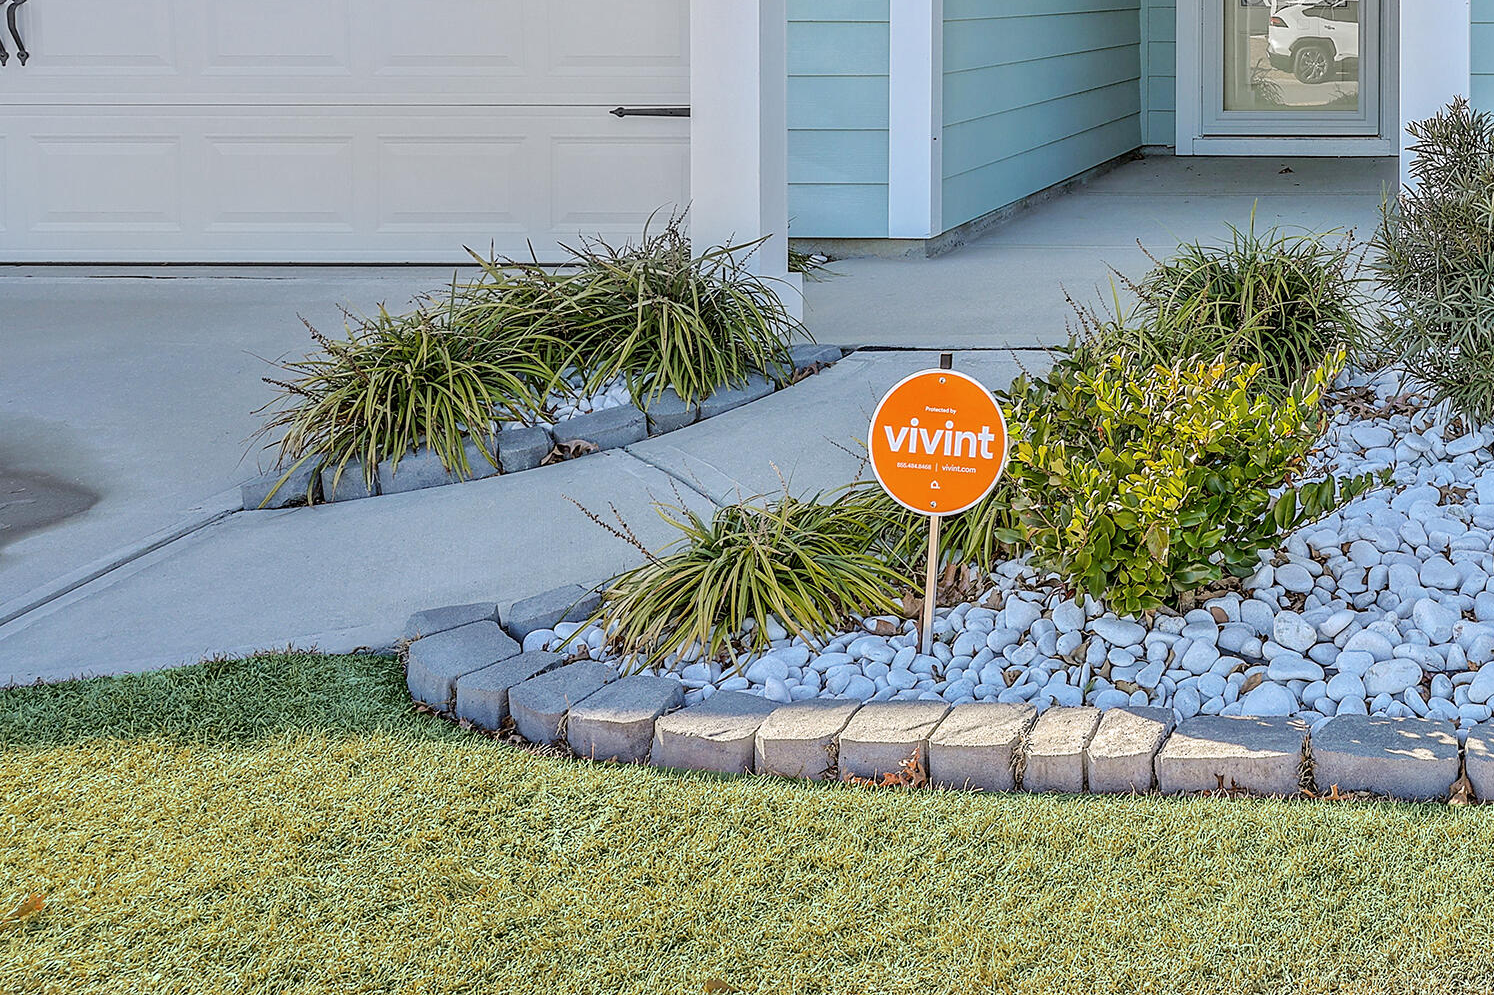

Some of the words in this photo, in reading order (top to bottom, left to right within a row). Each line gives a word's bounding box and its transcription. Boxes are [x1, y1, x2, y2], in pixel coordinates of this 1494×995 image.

[925, 405, 949, 413] Protected
[949, 407, 957, 415] by
[884, 417, 995, 459] vivint
[941, 464, 977, 473] vivint.com
